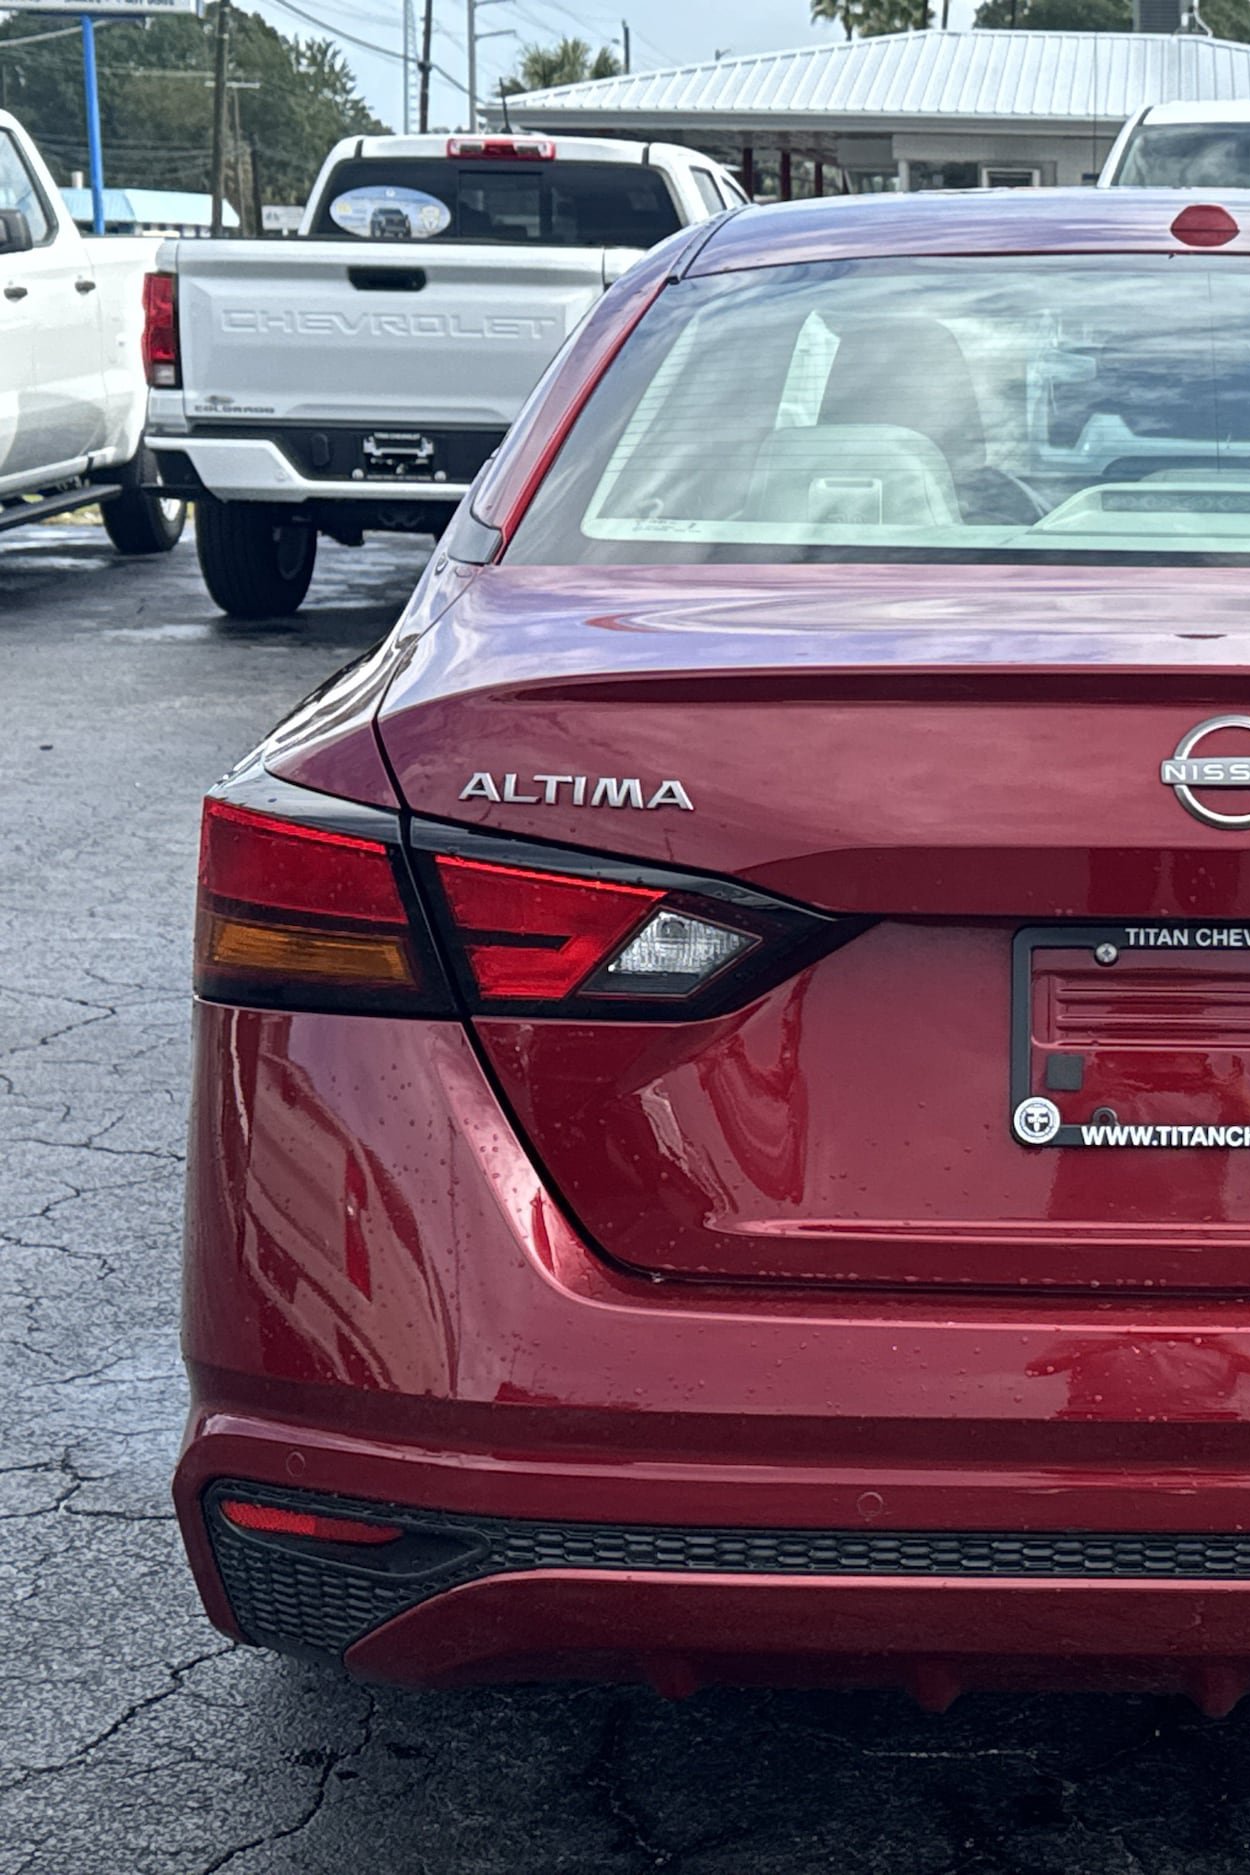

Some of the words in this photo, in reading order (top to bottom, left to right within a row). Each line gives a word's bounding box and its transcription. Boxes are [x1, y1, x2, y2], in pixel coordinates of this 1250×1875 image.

[221, 309, 556, 340] CHEVROLET
[458, 772, 694, 811] ALTIMA
[1125, 928, 1189, 947] TITAN
